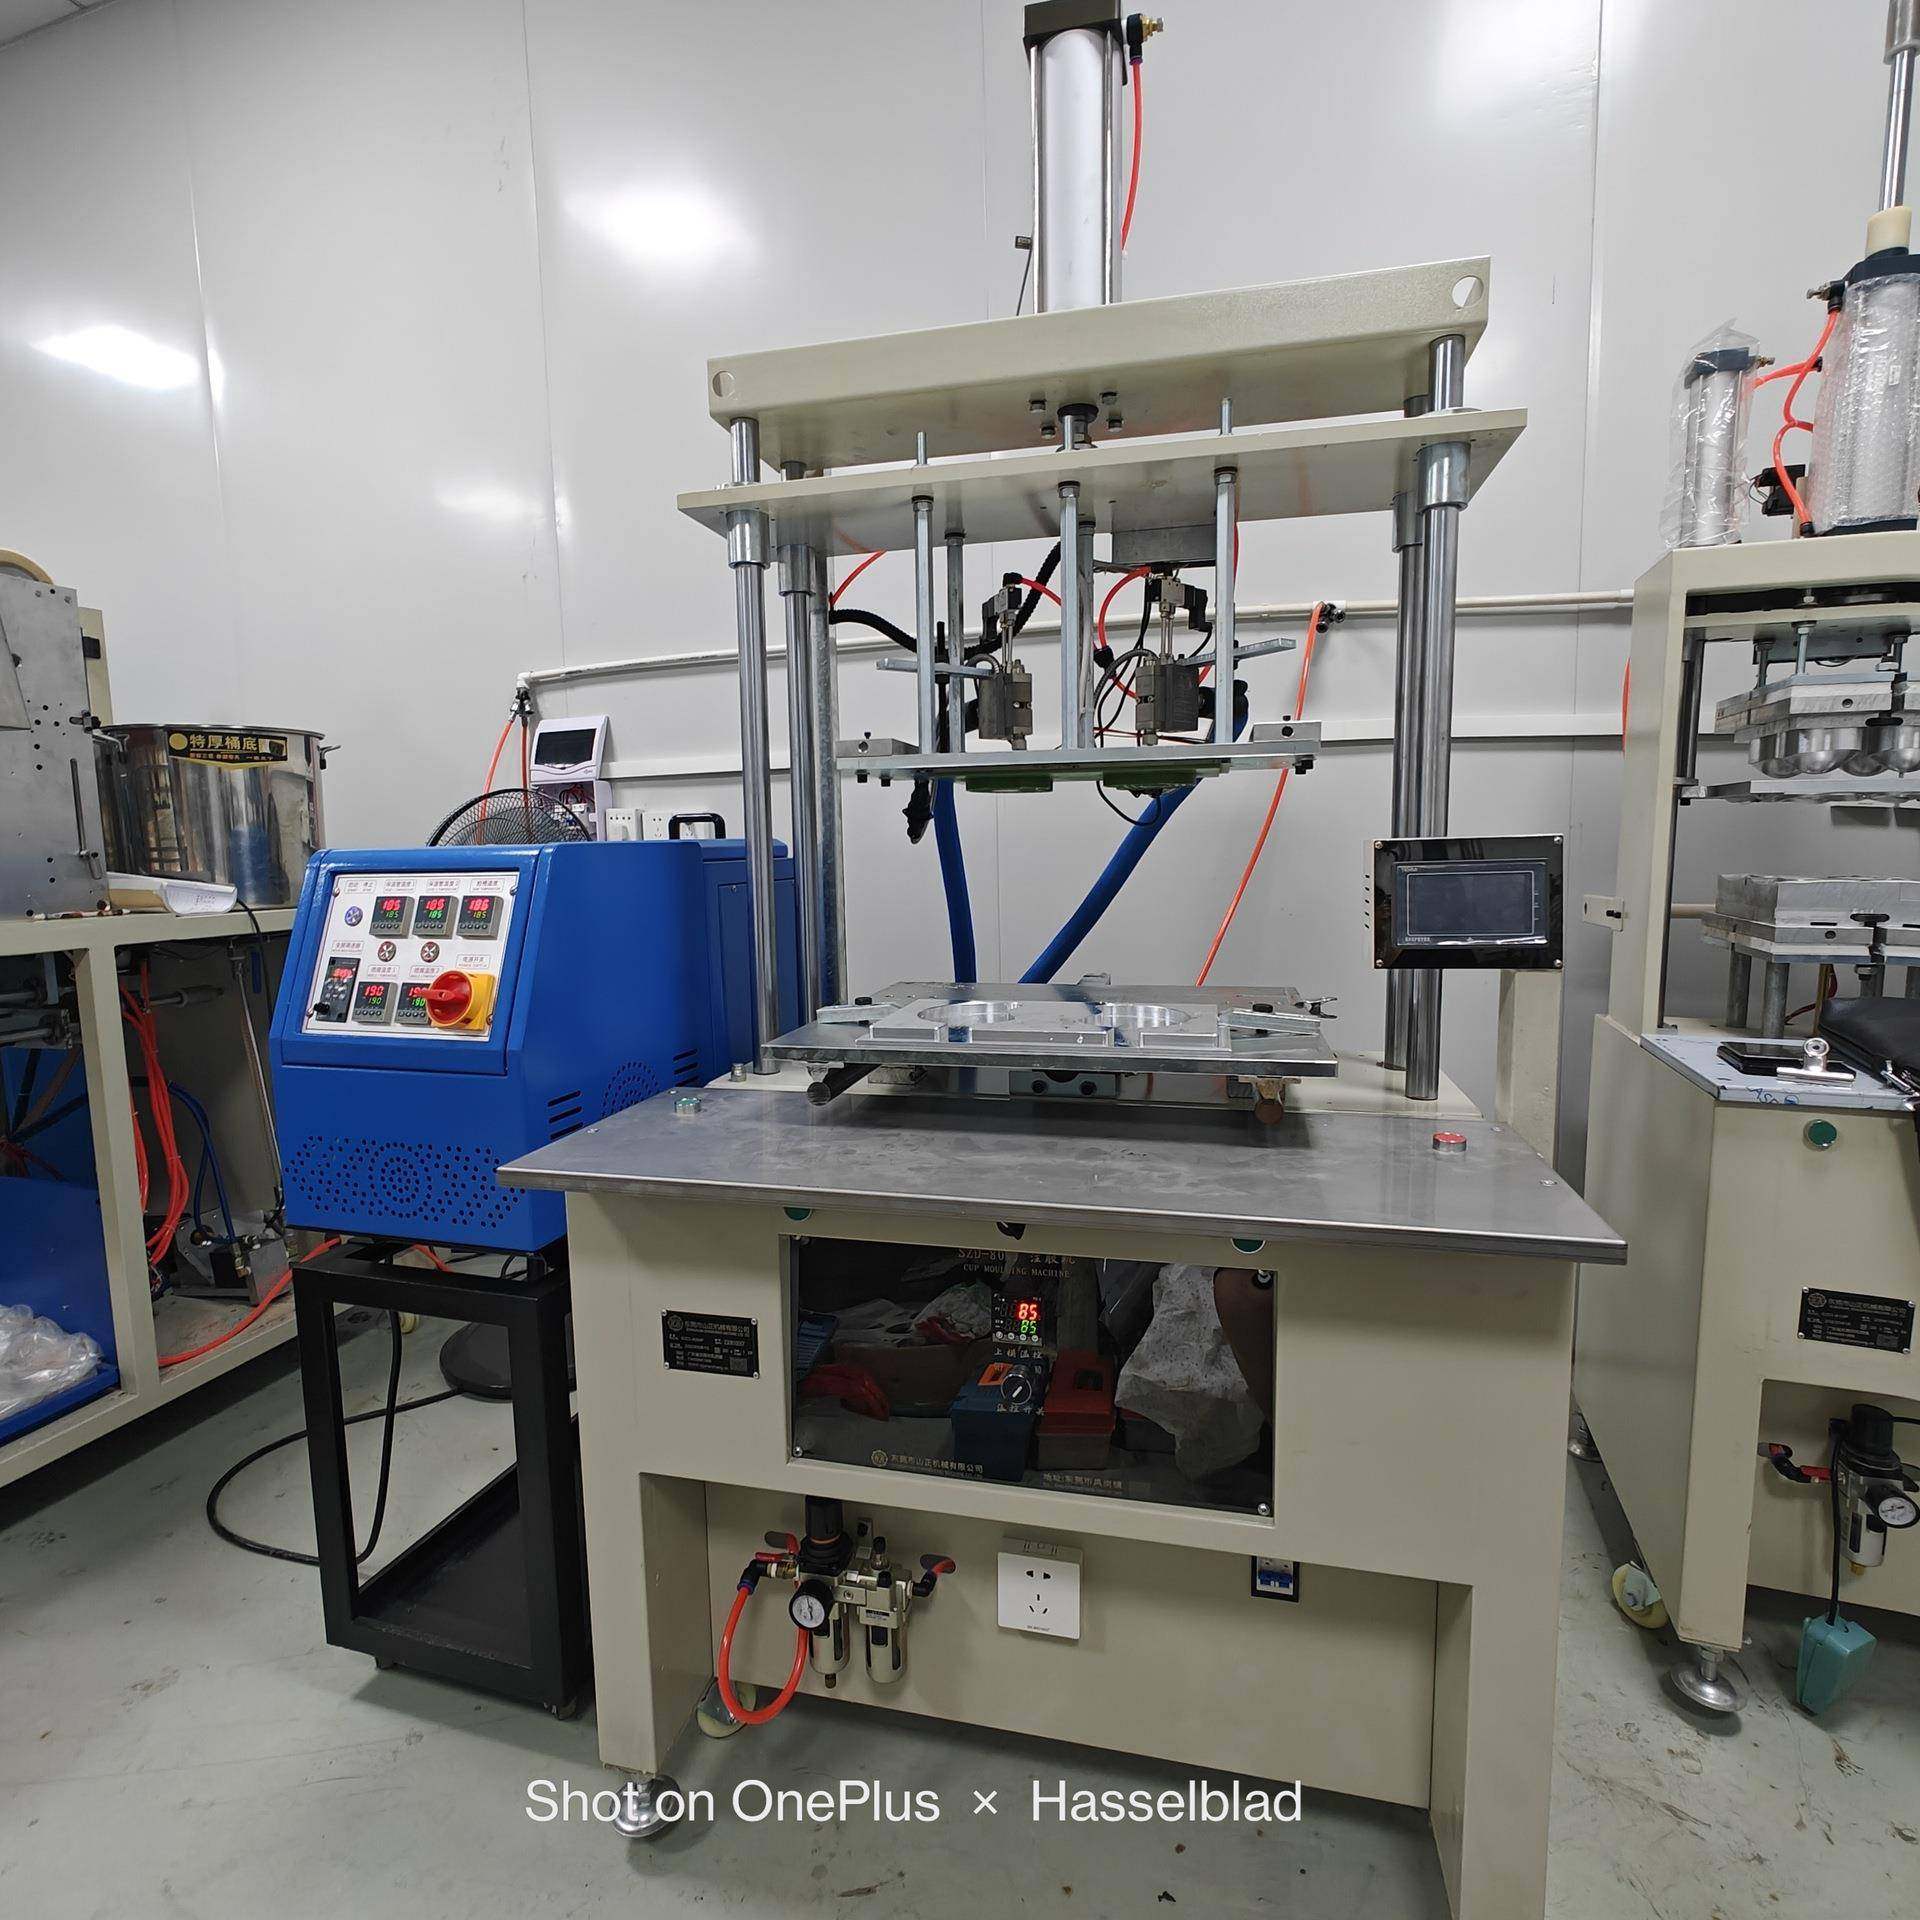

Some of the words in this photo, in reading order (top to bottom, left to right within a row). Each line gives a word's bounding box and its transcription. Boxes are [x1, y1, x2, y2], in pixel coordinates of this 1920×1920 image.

[189, 734, 257, 751] 特厚桶底
[365, 985, 384, 997] 190
[963, 1263, 980, 1273] CUP
[983, 1264, 1029, 1277] MOULING
[1031, 1267, 1071, 1279] MACHINE
[1018, 1303, 1038, 1320] 85
[1020, 1320, 1037, 1334] 85
